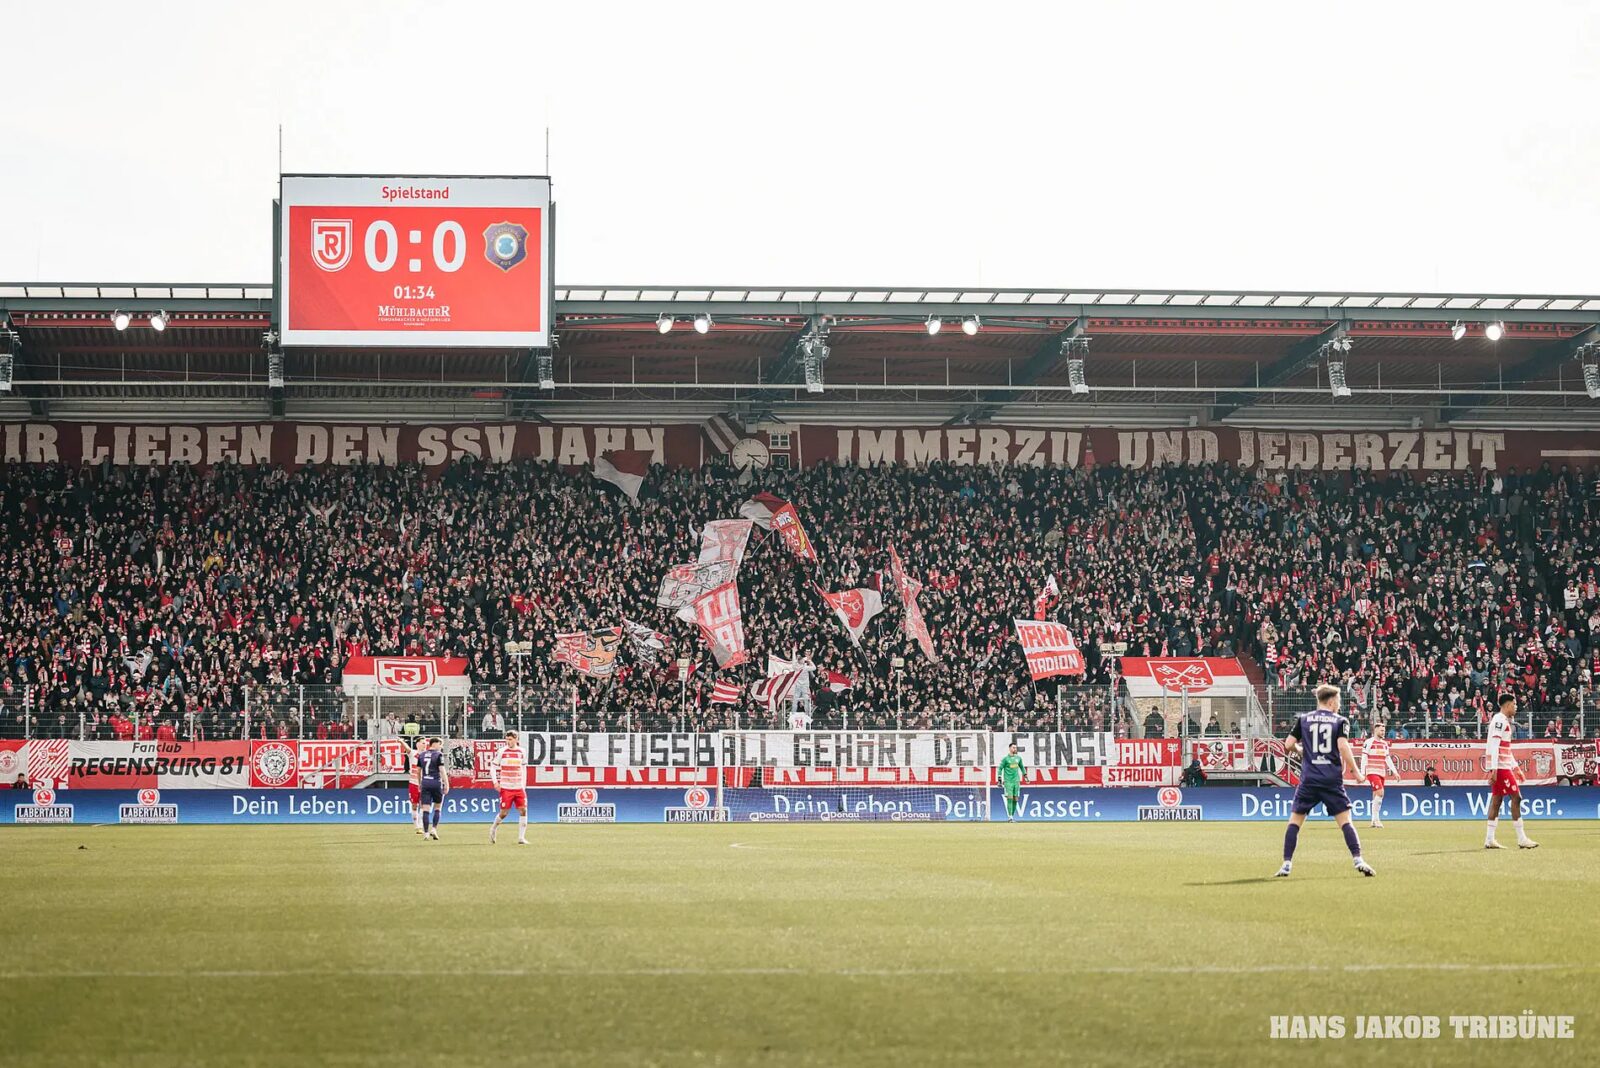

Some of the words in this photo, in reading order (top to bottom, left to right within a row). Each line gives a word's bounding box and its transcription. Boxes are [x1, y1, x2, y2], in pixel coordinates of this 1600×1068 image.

[381, 186, 449, 202] Spielstand
[364, 220, 467, 273] 0:0
[393, 286, 435, 299] 01:34
[80, 425, 274, 465] LIEBEN
[295, 425, 399, 465] DEN
[417, 425, 516, 466] SSV
[537, 426, 664, 465] JAHN
[837, 428, 1082, 469] IMMERZU
[1117, 430, 1218, 469] UND
[1237, 430, 1505, 471] JEDERZEIT
[1309, 723, 1333, 754] 13
[132, 742, 182, 753] Fanclub
[528, 733, 590, 765] DER
[608, 733, 778, 766] FUSSBALL
[793, 733, 917, 766] GEHÖRT
[934, 733, 995, 766] DEN
[1011, 732, 1107, 766] FANS!
[70, 757, 216, 777] REGENSBURG
[220, 756, 244, 775] 81
[424, 757, 431, 775] 7
[1108, 768, 1162, 781] STADION
[232, 795, 279, 815] Dein
[289, 795, 356, 815] Leben.
[366, 795, 412, 815] Dein
[1002, 794, 1102, 818] Wasser.
[1401, 793, 1455, 816] Dein
[18, 807, 71, 818] LABERTALER
[122, 807, 174, 817] LABERTALER
[561, 807, 612, 817] LABERTALER
[668, 810, 727, 821] LABERTALER
[831, 811, 860, 819] Donau
[902, 811, 931, 819] Donau
[1141, 809, 1198, 821] LABERTALER
